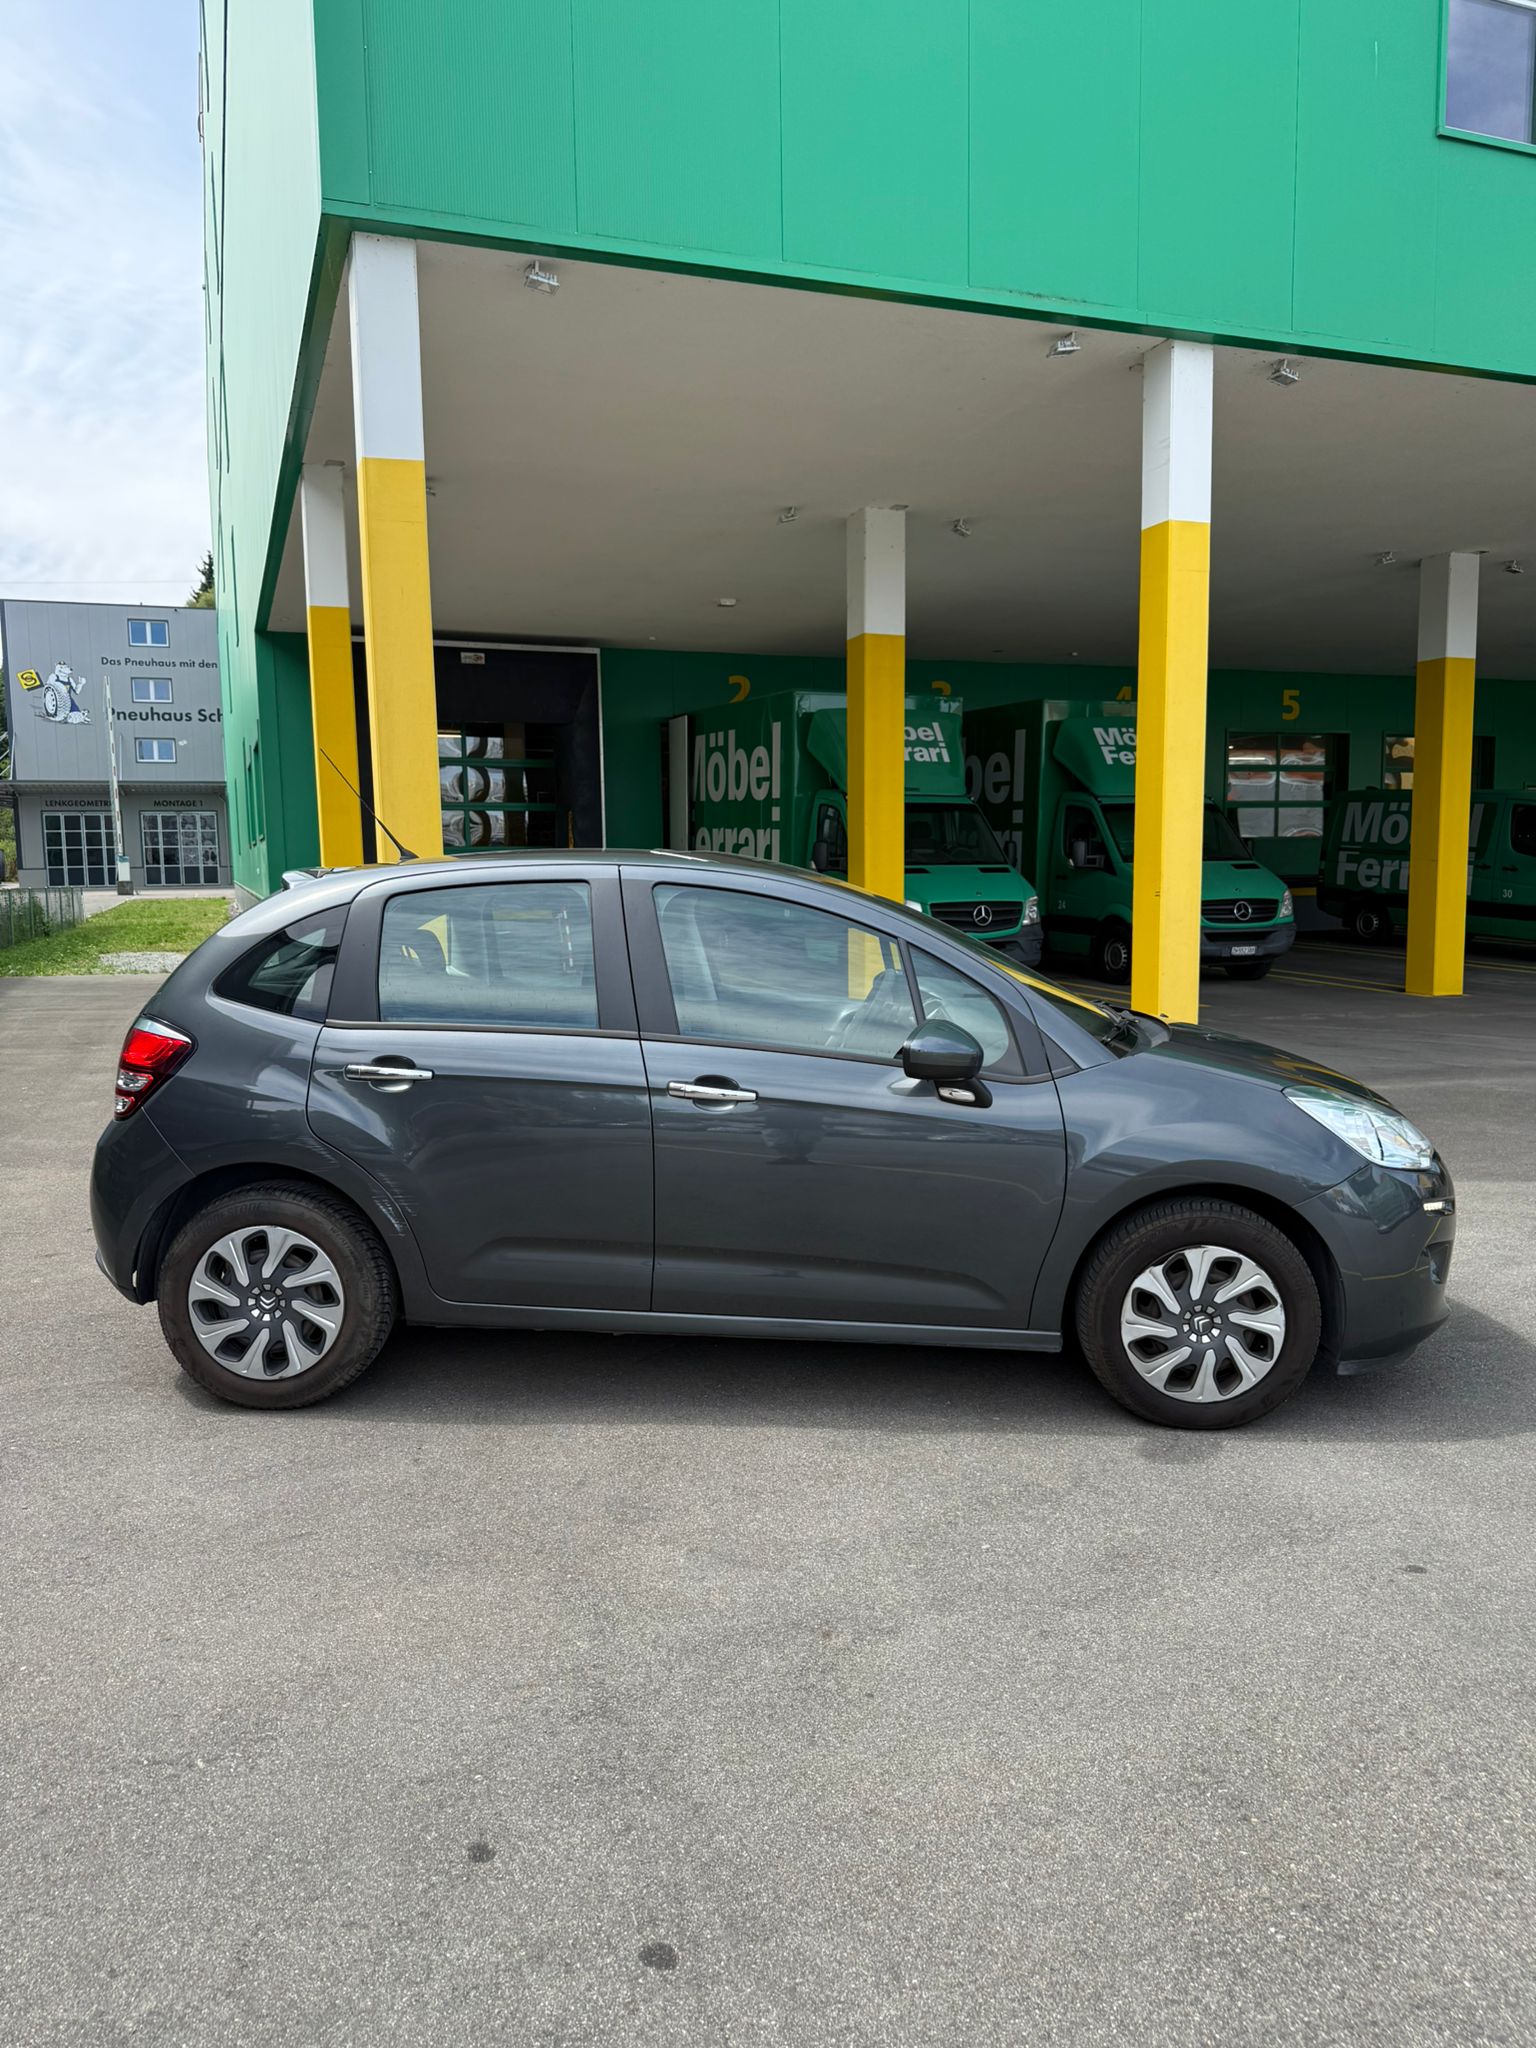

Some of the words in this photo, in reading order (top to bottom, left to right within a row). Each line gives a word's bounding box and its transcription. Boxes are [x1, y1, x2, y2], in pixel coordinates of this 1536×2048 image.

[101, 656, 121, 666] Das
[125, 657, 176, 668] Pneuhaus
[179, 659, 195, 668] mit
[198, 659, 218, 669] den
[1281, 689, 1301, 721] 5
[1092, 727, 1136, 746] Mö
[1100, 746, 1137, 765] Fe
[1502, 888, 1513, 898] 30
